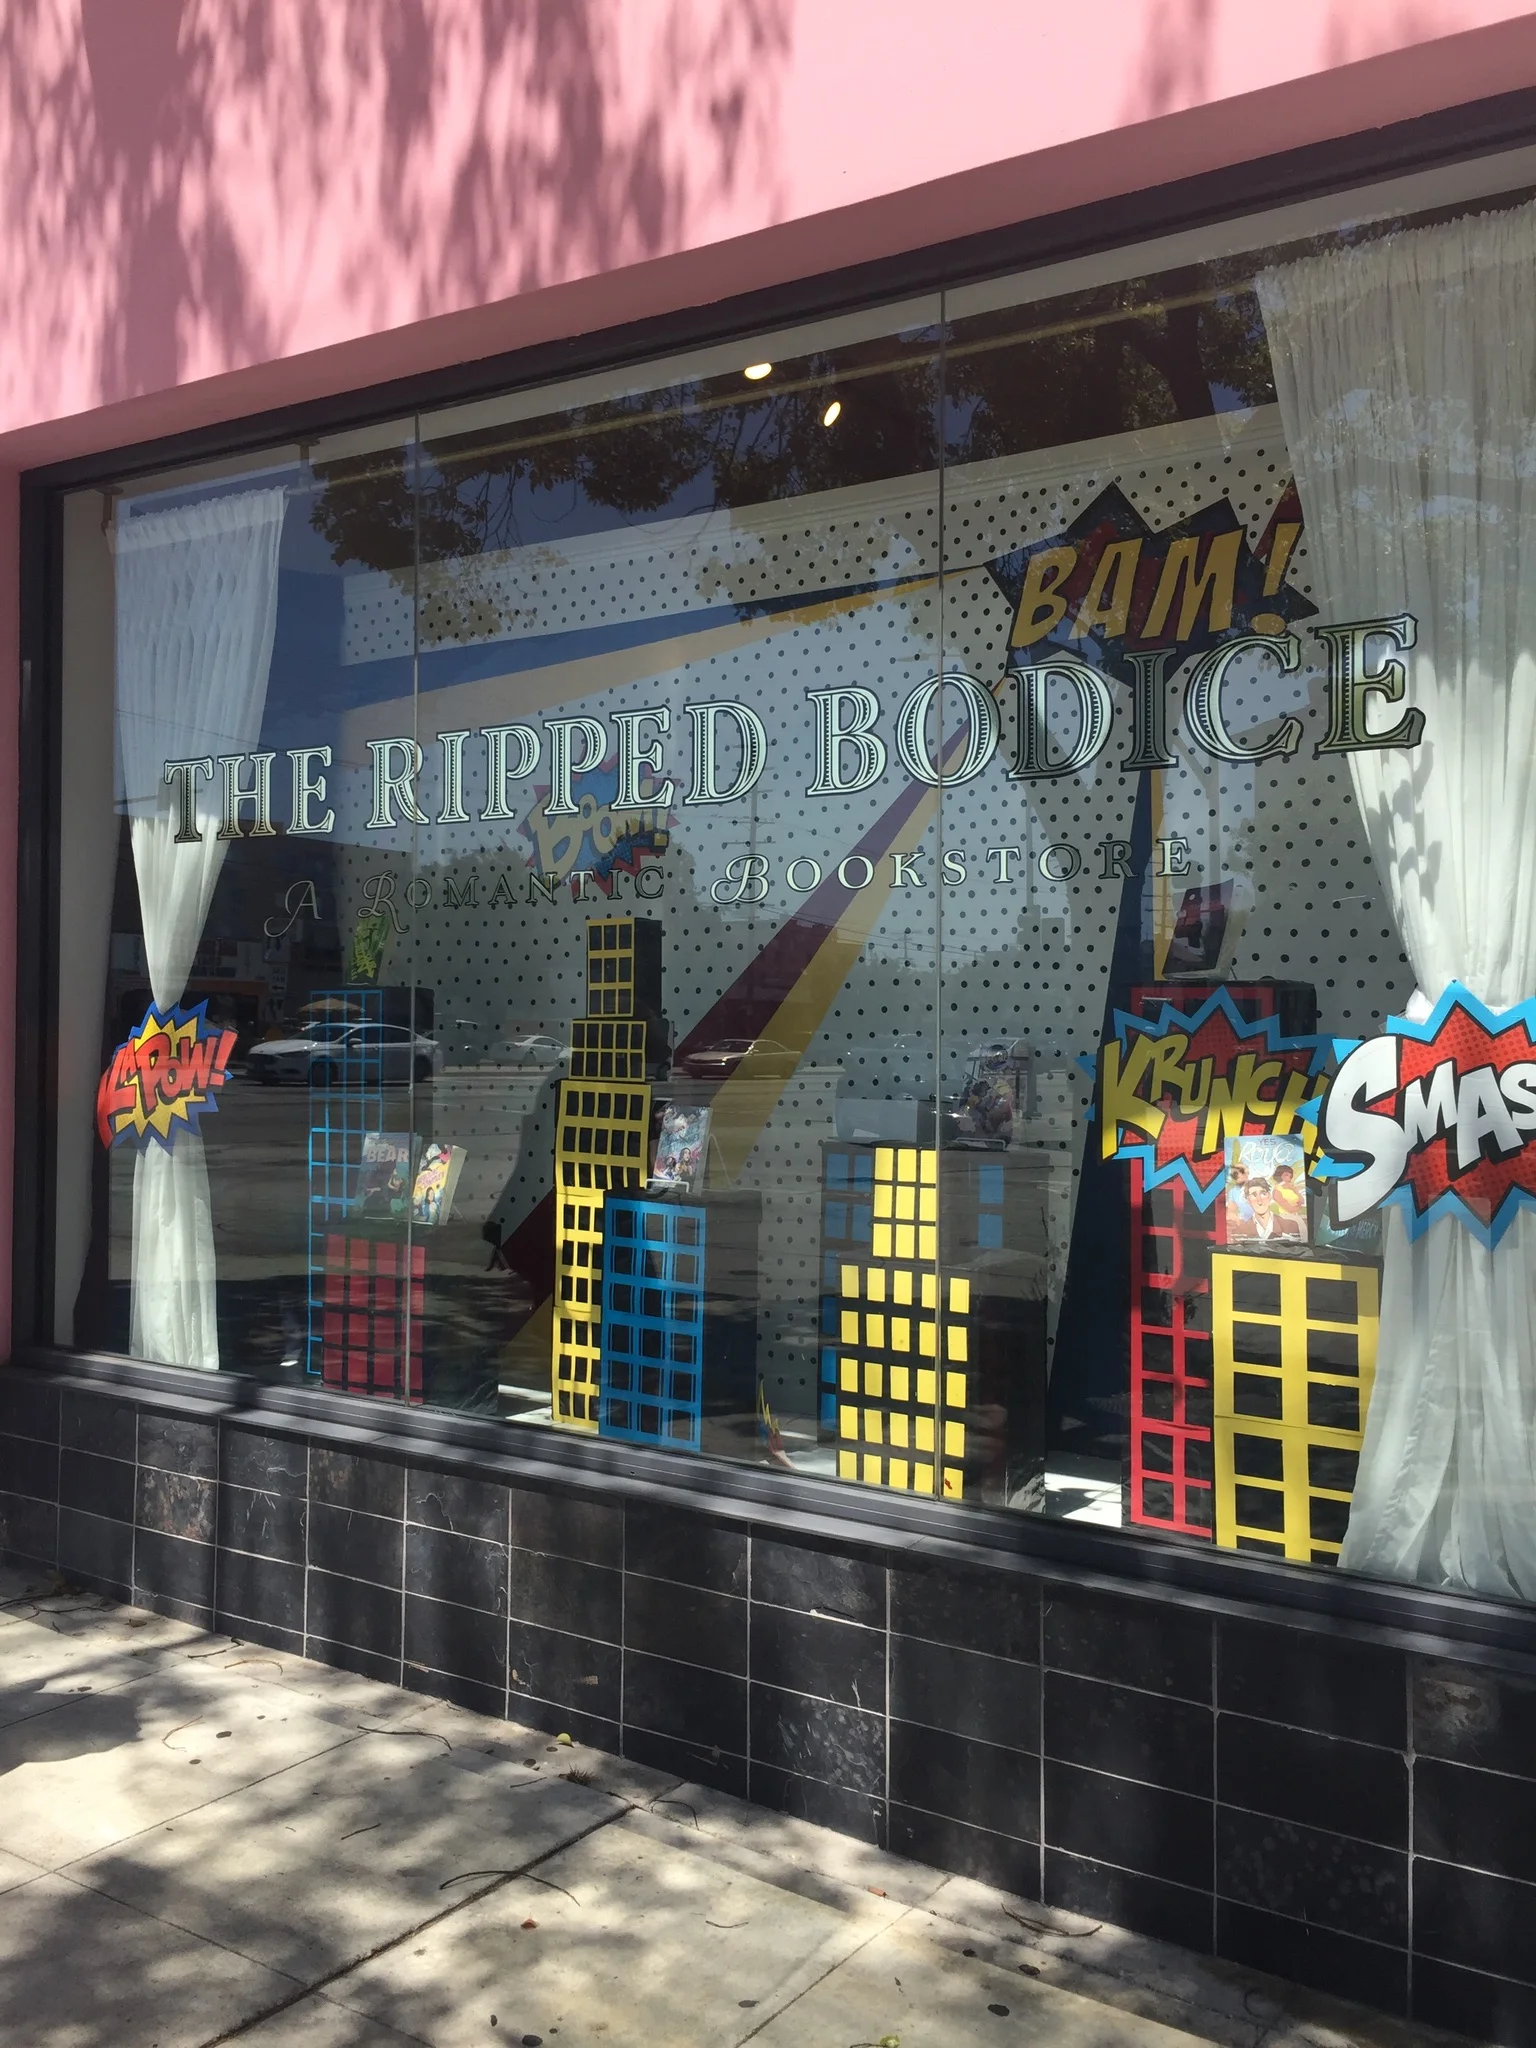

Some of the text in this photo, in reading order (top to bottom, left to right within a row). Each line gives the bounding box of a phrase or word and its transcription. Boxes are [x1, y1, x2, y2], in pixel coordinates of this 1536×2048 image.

[1011, 521, 1301, 648] BAM!
[163, 612, 1425, 844] THE RIPPED BODICE
[263, 836, 1195, 939] A ROMANTIC BOOKSTORE
[97, 1029, 238, 1150] KAPOW!
[366, 1146, 409, 1163] BEAR
